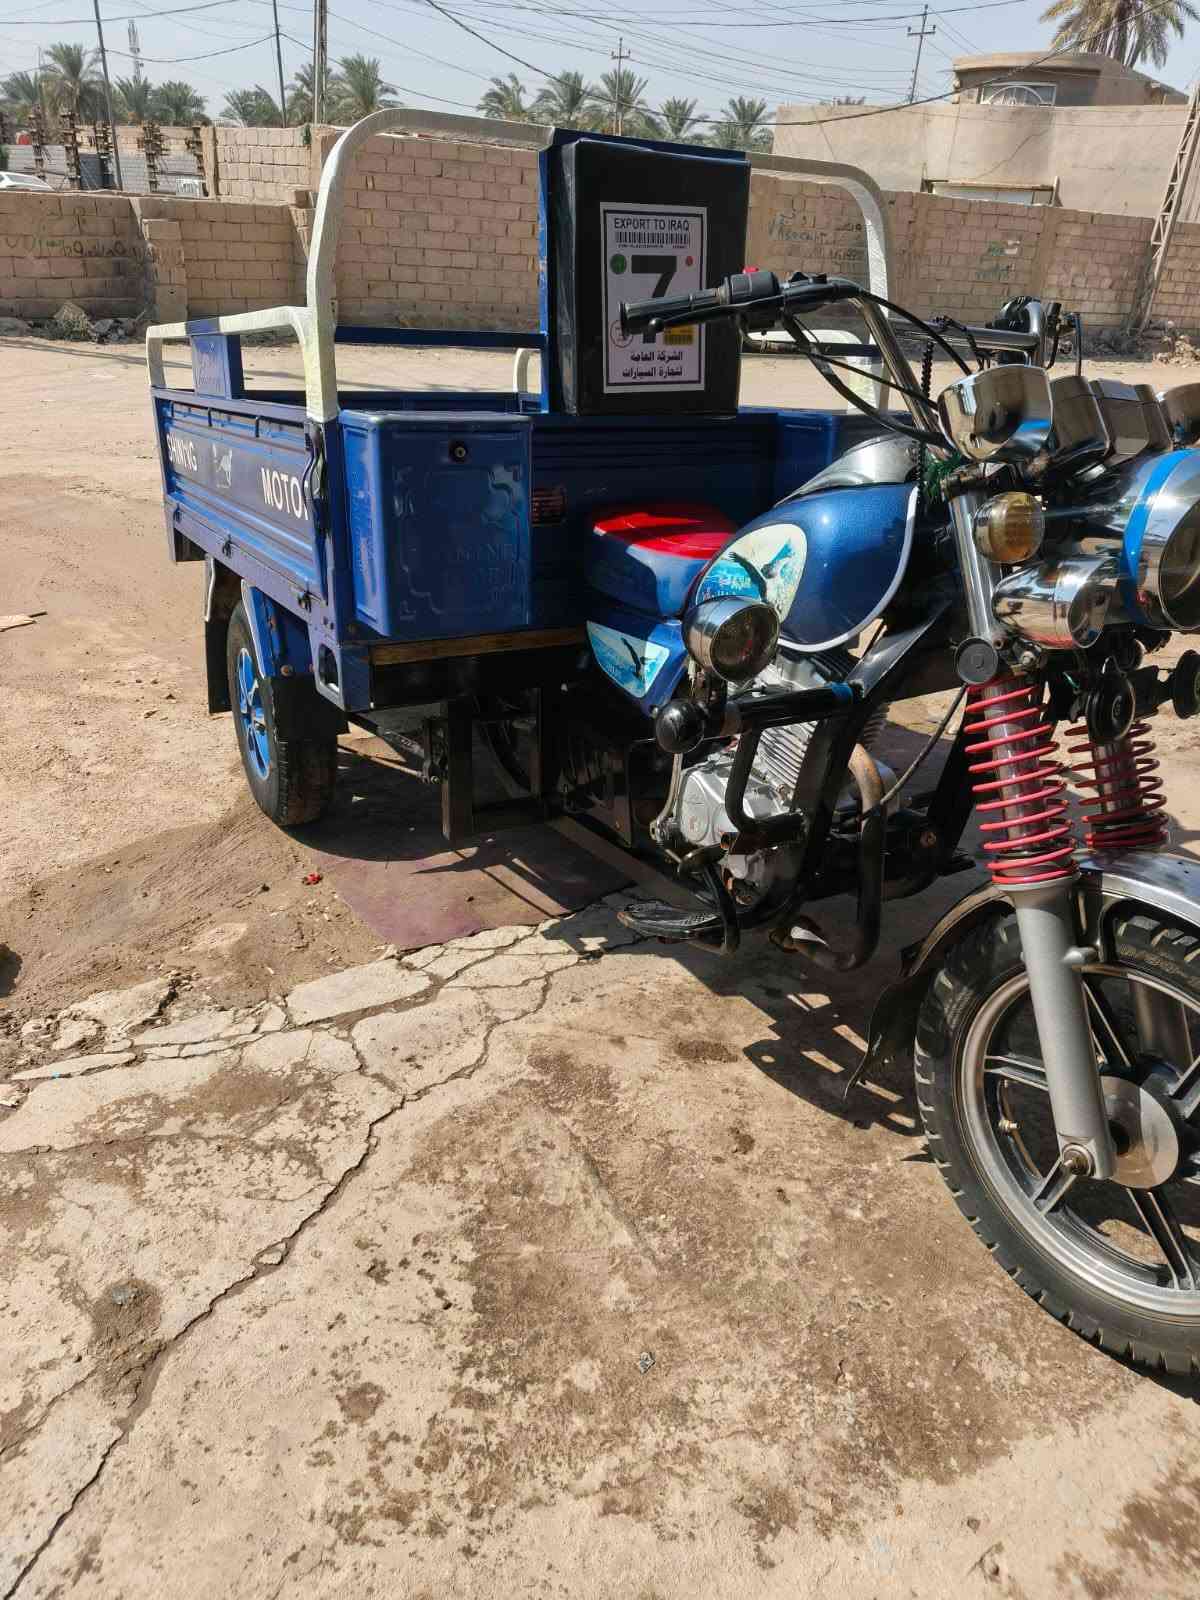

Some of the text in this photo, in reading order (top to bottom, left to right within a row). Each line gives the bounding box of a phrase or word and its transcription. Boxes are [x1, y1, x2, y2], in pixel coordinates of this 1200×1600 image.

[614, 217, 690, 232] EXPORT TO IRAQ
[631, 255, 677, 344] 7
[630, 351, 683, 364] الشركة العامة
[622, 366, 656, 379] السيارات
